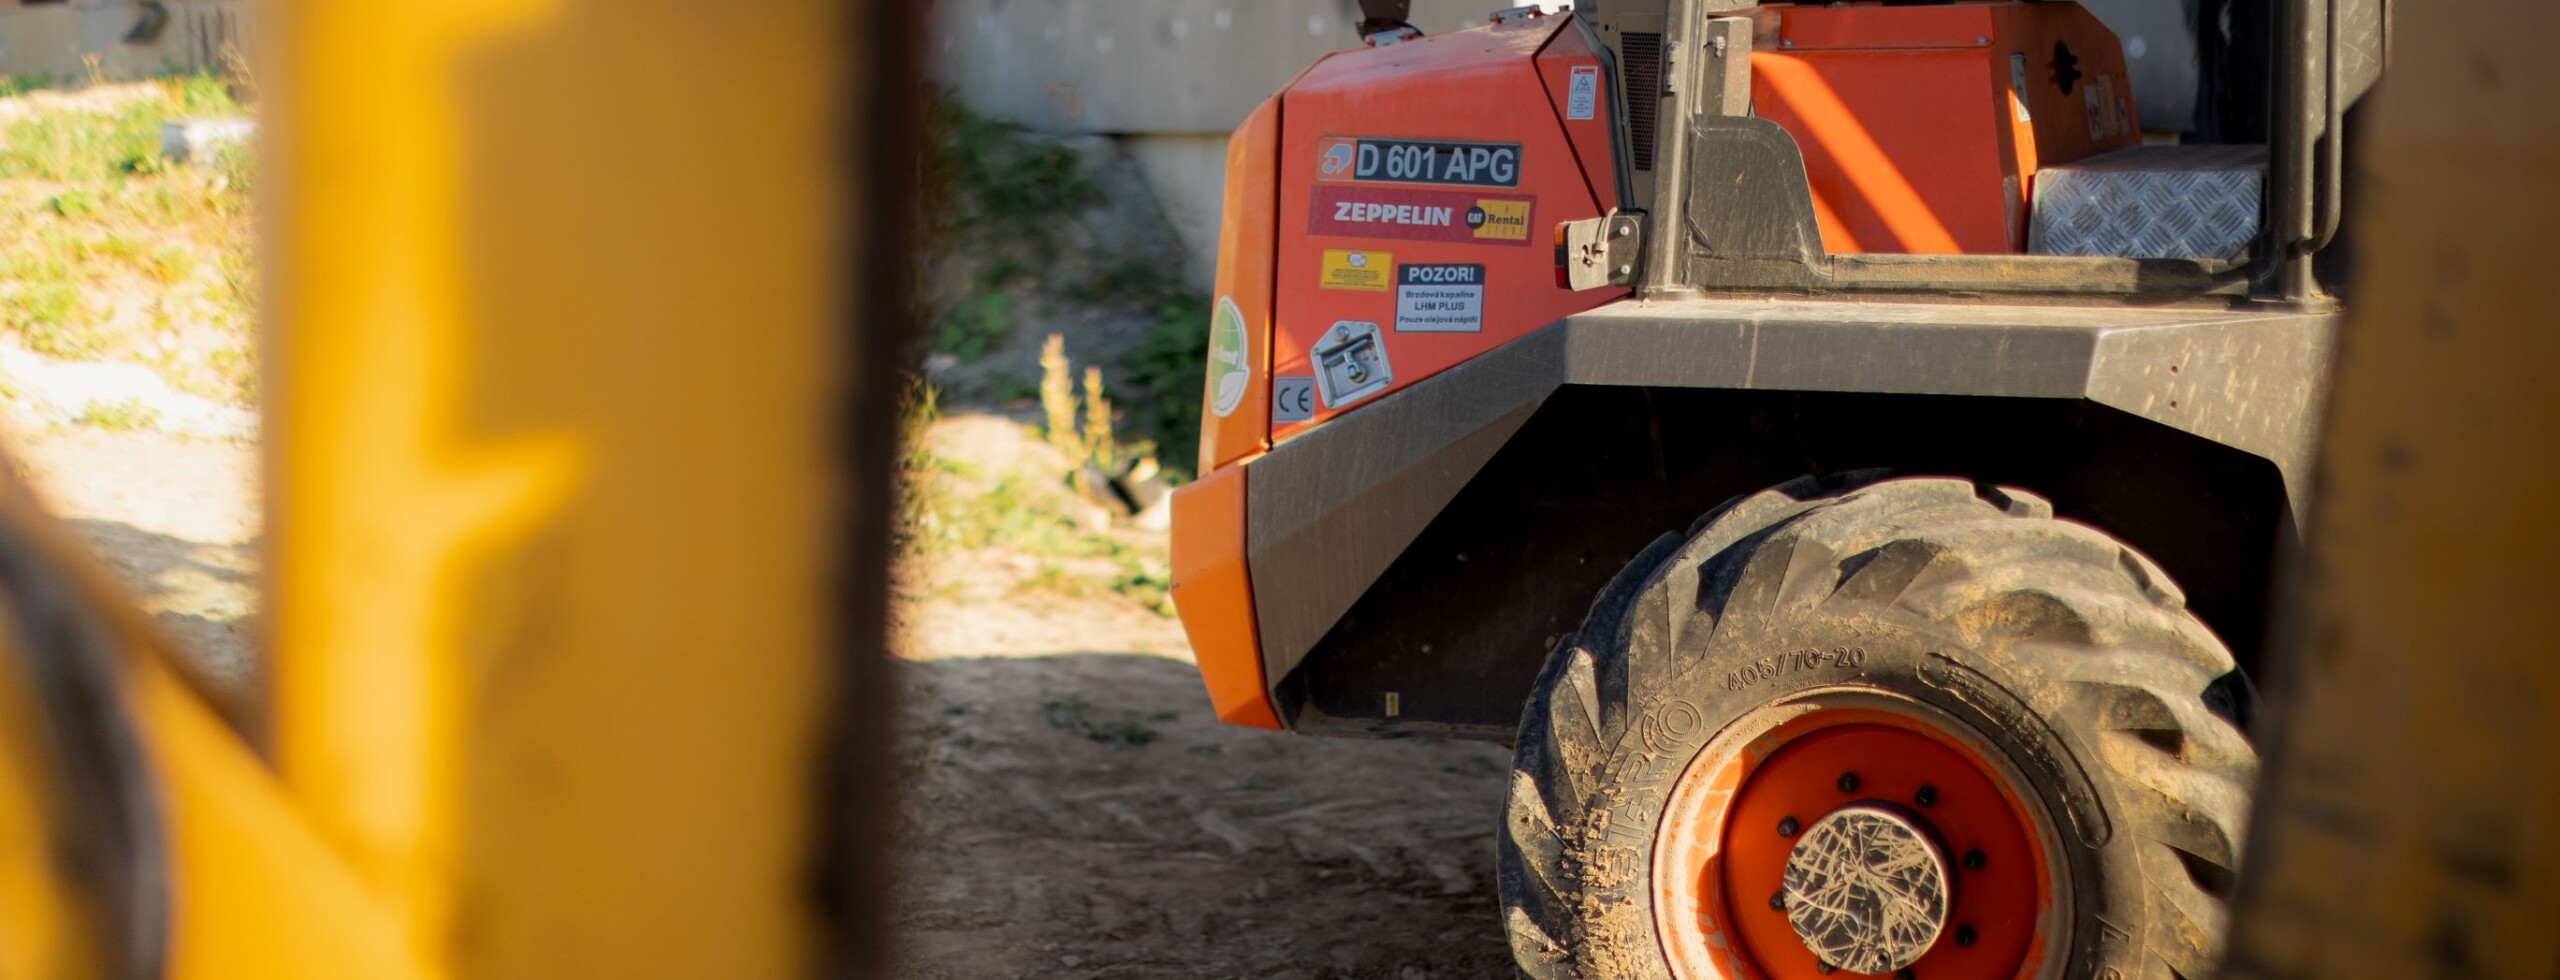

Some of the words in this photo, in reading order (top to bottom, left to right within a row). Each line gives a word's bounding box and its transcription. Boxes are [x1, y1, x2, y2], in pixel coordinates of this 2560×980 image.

[1356, 143, 1379, 177] D
[1387, 145, 1436, 179] 601
[1444, 147, 1515, 183] APG
[1334, 201, 1450, 226] ZEPPELIN
[1467, 212, 1483, 223] CAT
[1488, 214, 1525, 225] Rental
[1408, 267, 1474, 282] POZOR!
[1440, 291, 1475, 300] kapalina
[1414, 302, 1436, 311] LHM
[1438, 302, 1465, 311] PLUS
[1278, 386, 1310, 413] CE
[1727, 646, 1866, 692] 405/70-20
